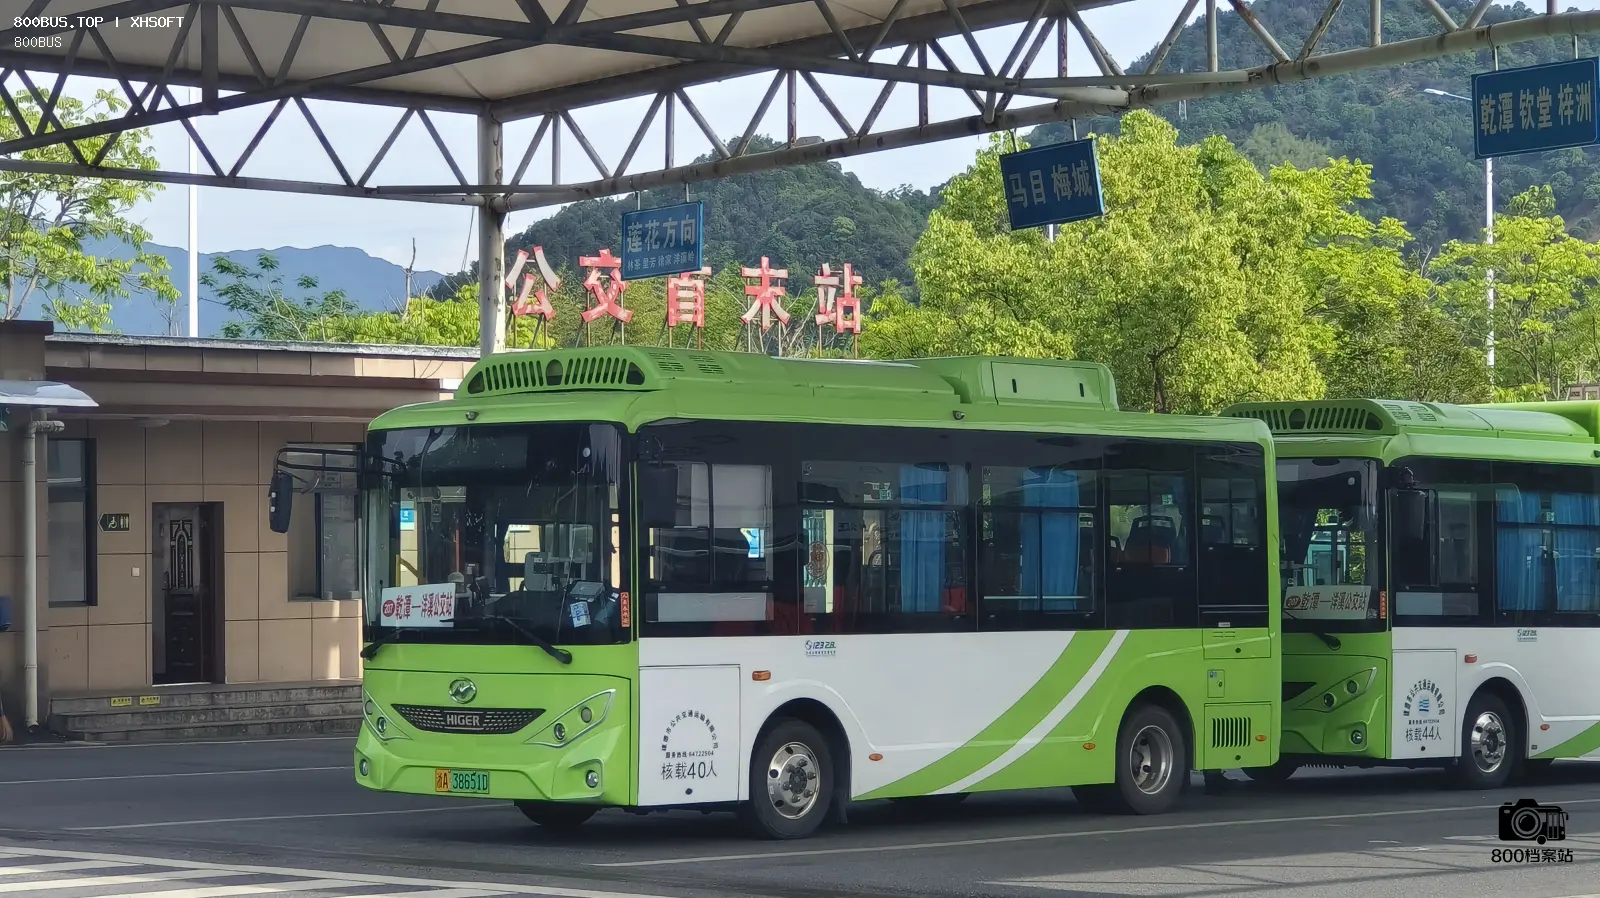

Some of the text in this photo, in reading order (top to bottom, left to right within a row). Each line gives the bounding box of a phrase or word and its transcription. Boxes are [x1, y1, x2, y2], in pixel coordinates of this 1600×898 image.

[1480, 80, 1592, 136] 乾潭 钦堂 梓洲
[1008, 159, 1093, 209] 马目 梅城
[627, 214, 696, 253] 莲花方向
[505, 246, 863, 334] 公交首末站
[383, 603, 394, 614] 207
[1286, 596, 1299, 608] 207
[446, 714, 480, 727] HIGER
[1405, 726, 1442, 742] 核载44人
[661, 760, 718, 781] 核载40人
